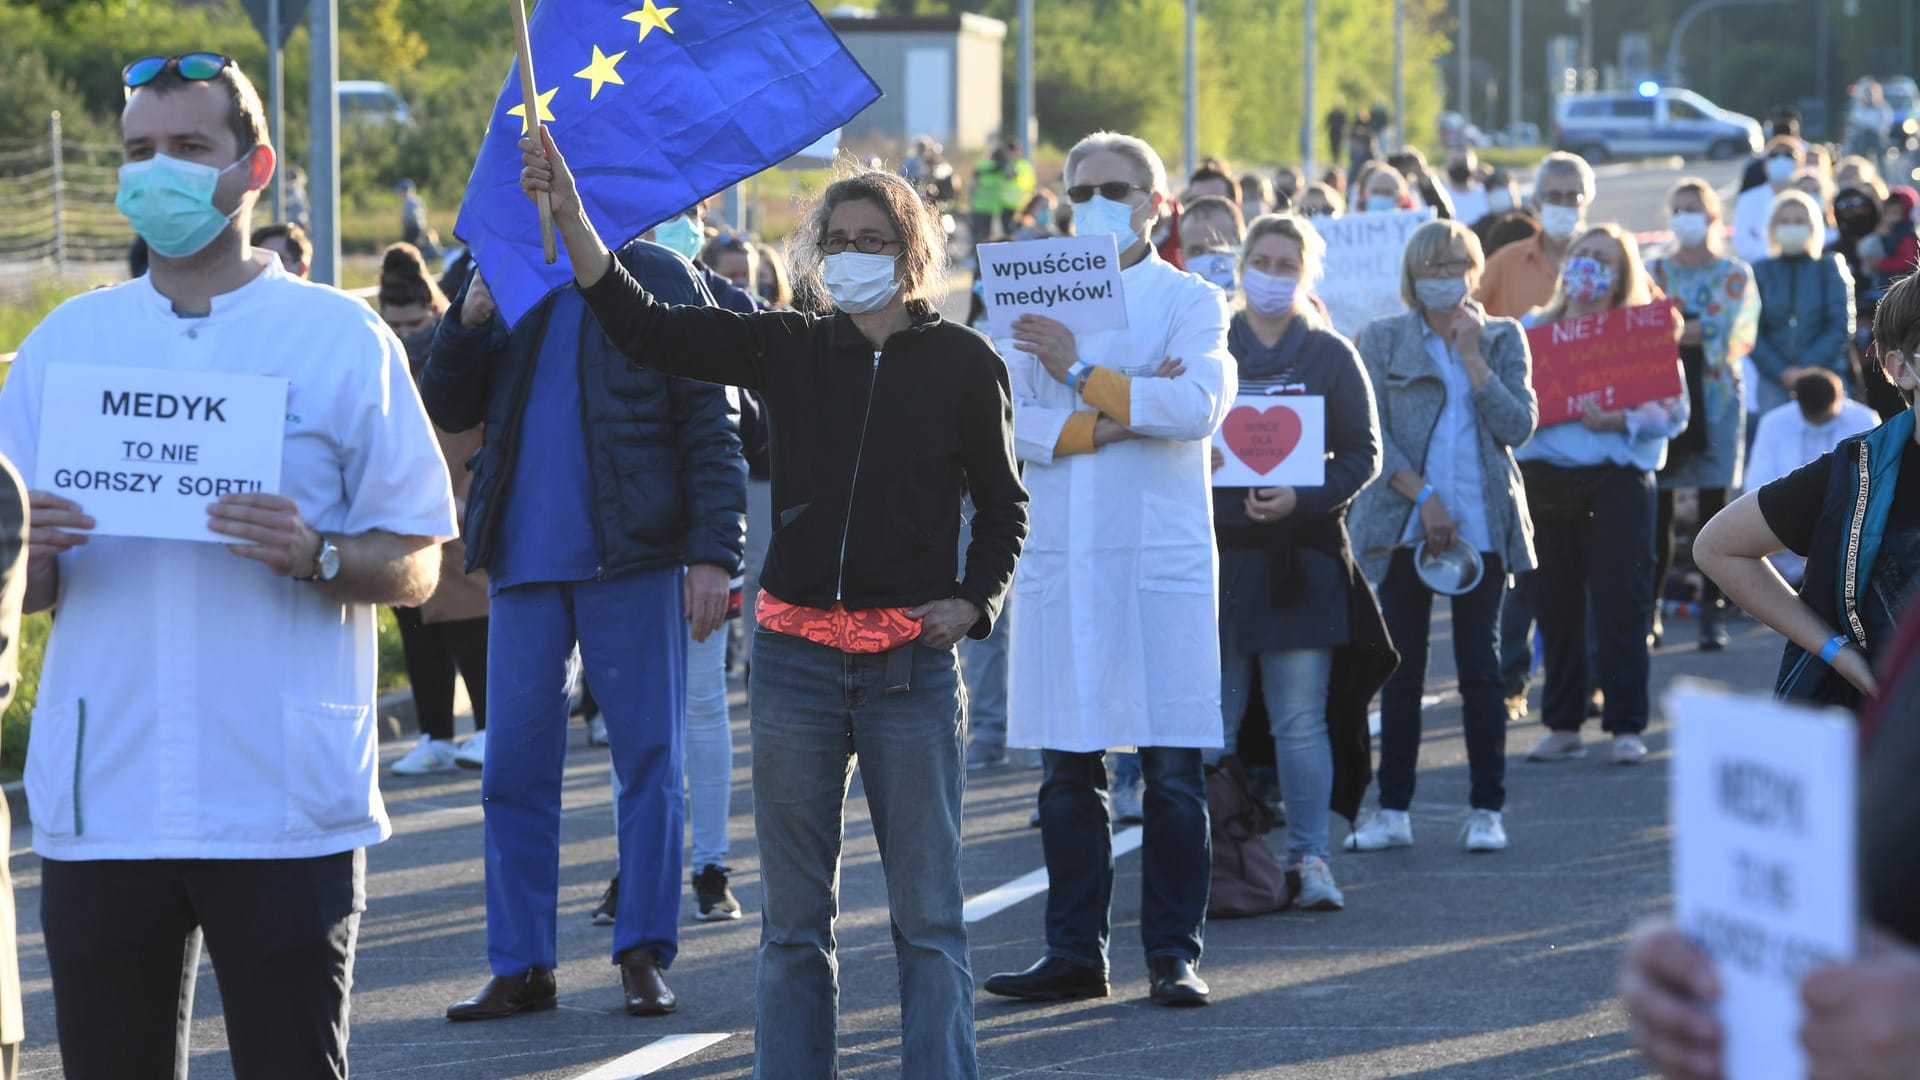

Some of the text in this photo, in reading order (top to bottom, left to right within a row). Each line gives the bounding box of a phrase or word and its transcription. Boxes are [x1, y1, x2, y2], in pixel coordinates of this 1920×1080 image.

[992, 252, 1106, 280] wpuśćcie
[995, 280, 1113, 307] medyków!
[101, 390, 227, 422] MEDYK
[122, 440, 199, 462] TO NIE
[54, 468, 163, 493] GORSZY
